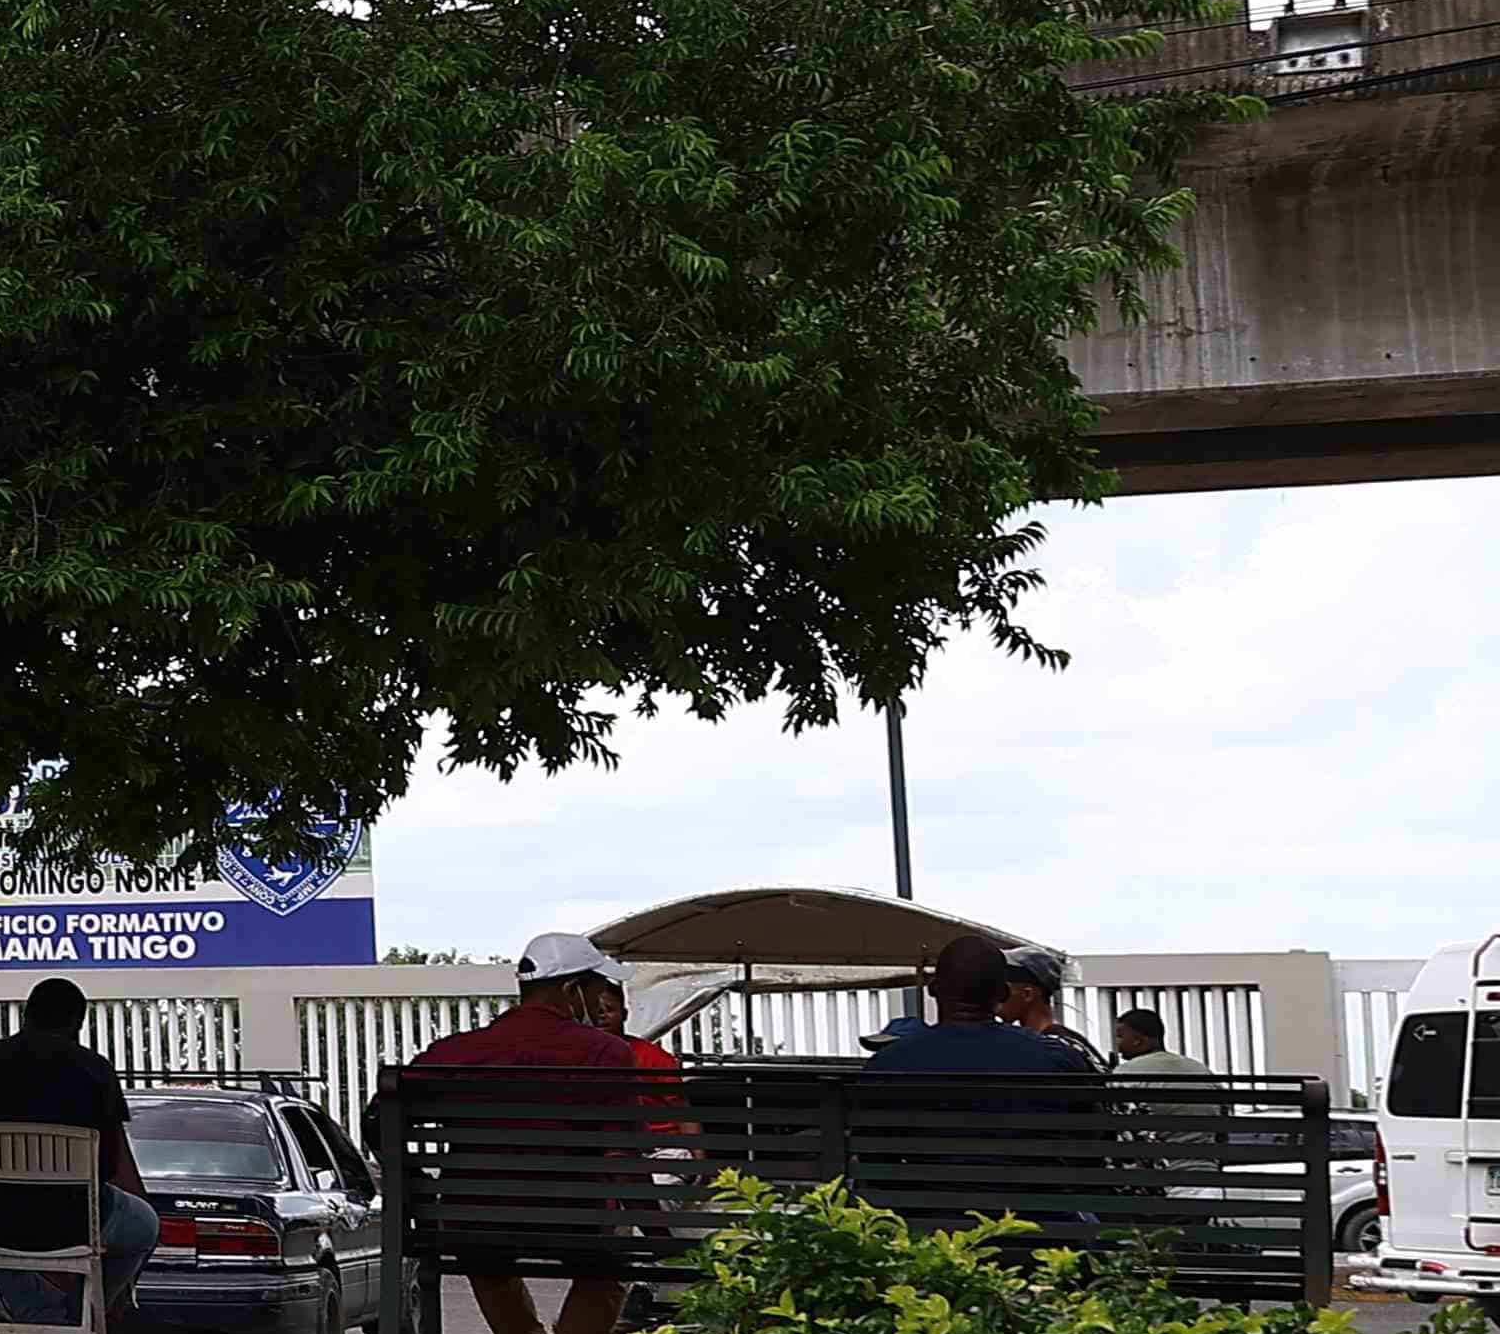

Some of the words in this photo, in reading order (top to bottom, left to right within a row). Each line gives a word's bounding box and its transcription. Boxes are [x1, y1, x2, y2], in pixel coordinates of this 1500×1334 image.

[115, 866, 197, 893] NORTE
[66, 911, 225, 934] FORMATIVO
[88, 934, 196, 960] TINGO
